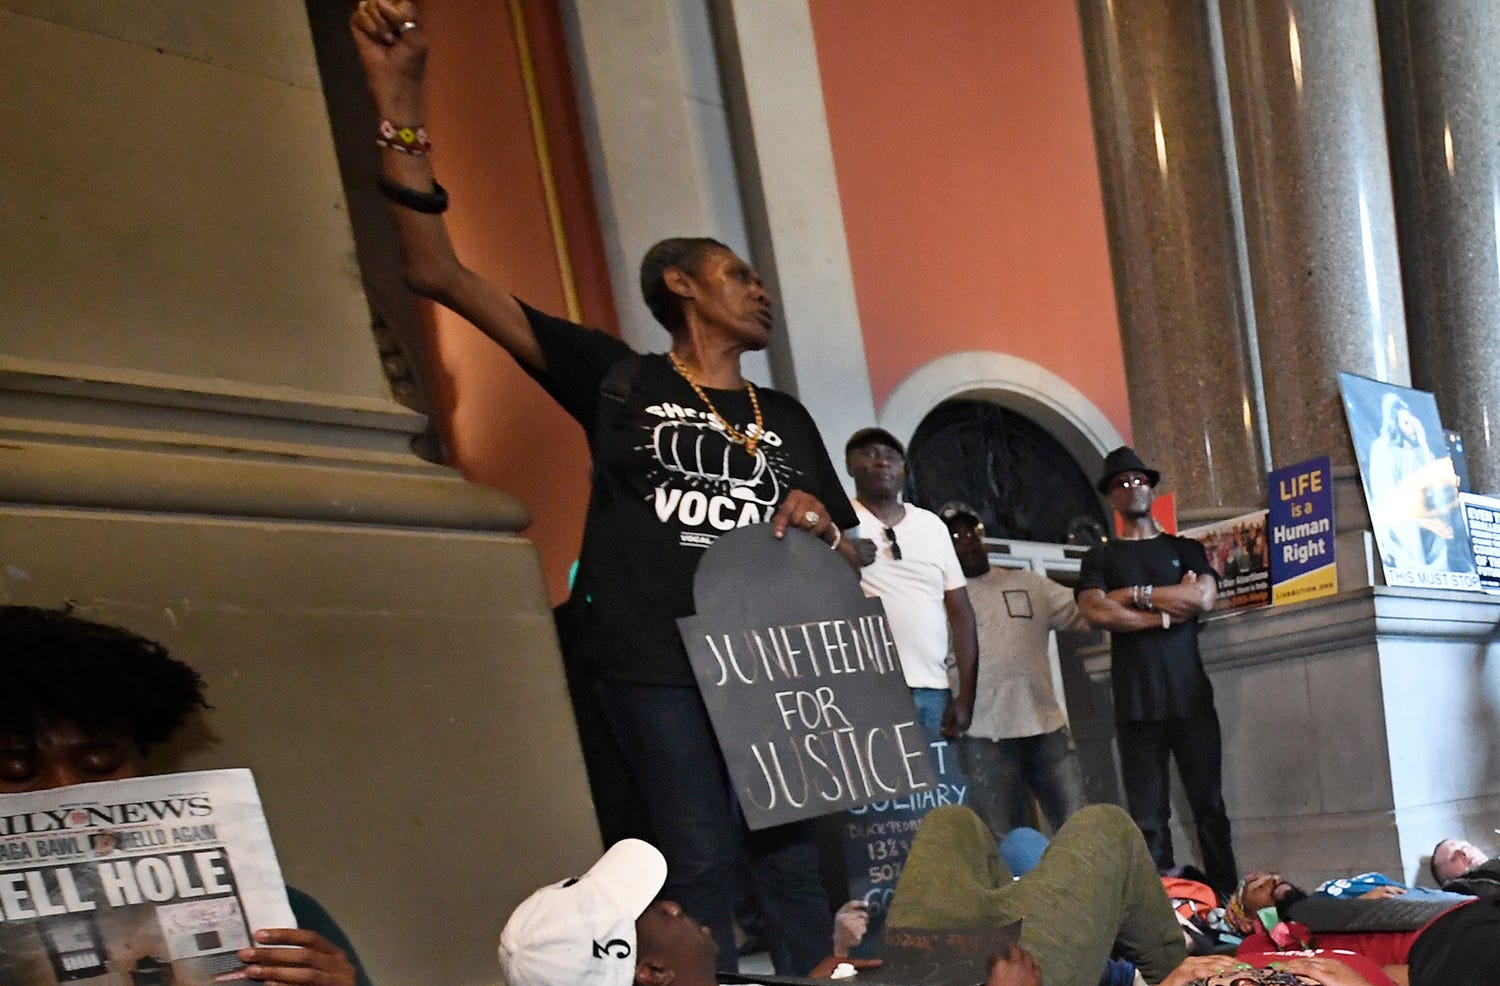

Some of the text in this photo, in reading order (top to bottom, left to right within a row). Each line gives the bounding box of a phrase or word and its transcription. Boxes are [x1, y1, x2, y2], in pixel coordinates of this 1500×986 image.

[1280, 470, 1323, 501] LIFE
[1291, 502, 1313, 517] is a
[1274, 517, 1330, 544] Human
[1283, 538, 1326, 563] Right
[1388, 569, 1415, 584] THIS
[1418, 571, 1448, 586] MUST
[1451, 573, 1479, 588] STOP
[774, 686, 854, 731] FOR
[749, 721, 930, 809] JUSTICE
[83, 796, 213, 829] NEWS
[36, 836, 84, 858] BAWL
[867, 838, 899, 861] 13%
[97, 851, 233, 908] HOLE
